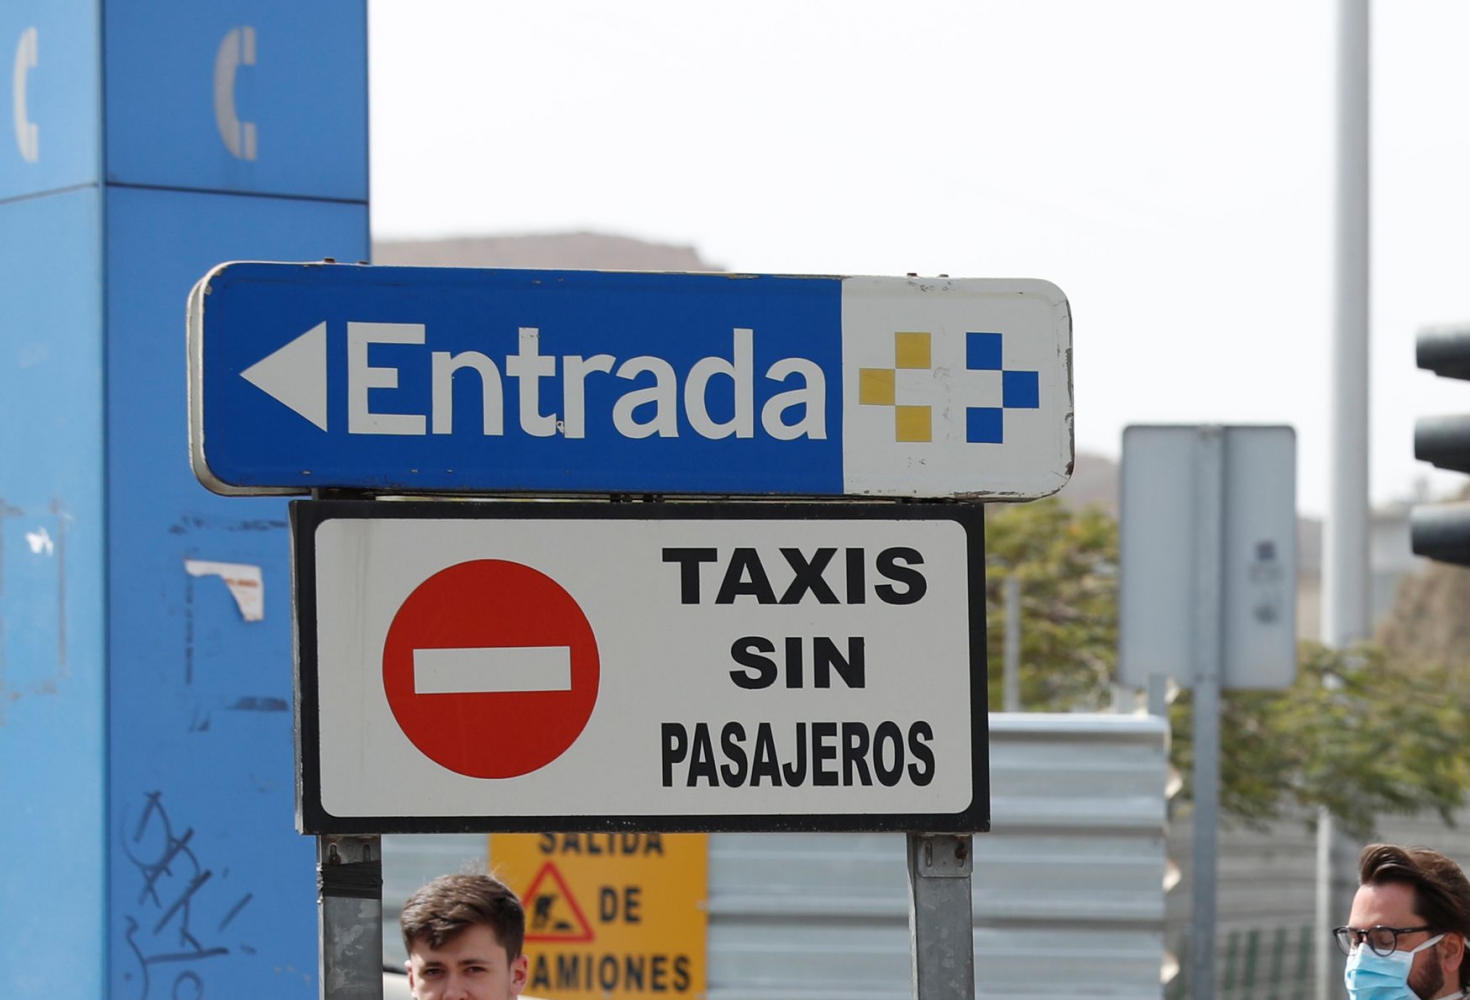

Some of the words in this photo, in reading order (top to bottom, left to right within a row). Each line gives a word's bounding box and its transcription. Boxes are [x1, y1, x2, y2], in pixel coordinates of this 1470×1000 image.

[347, 321, 828, 441] Entrada
[661, 546, 928, 606] TAXIS
[728, 636, 866, 690] SIN
[661, 720, 936, 788] PASAJEROS
[599, 885, 642, 924] DE
[530, 953, 692, 994] AMIONES
